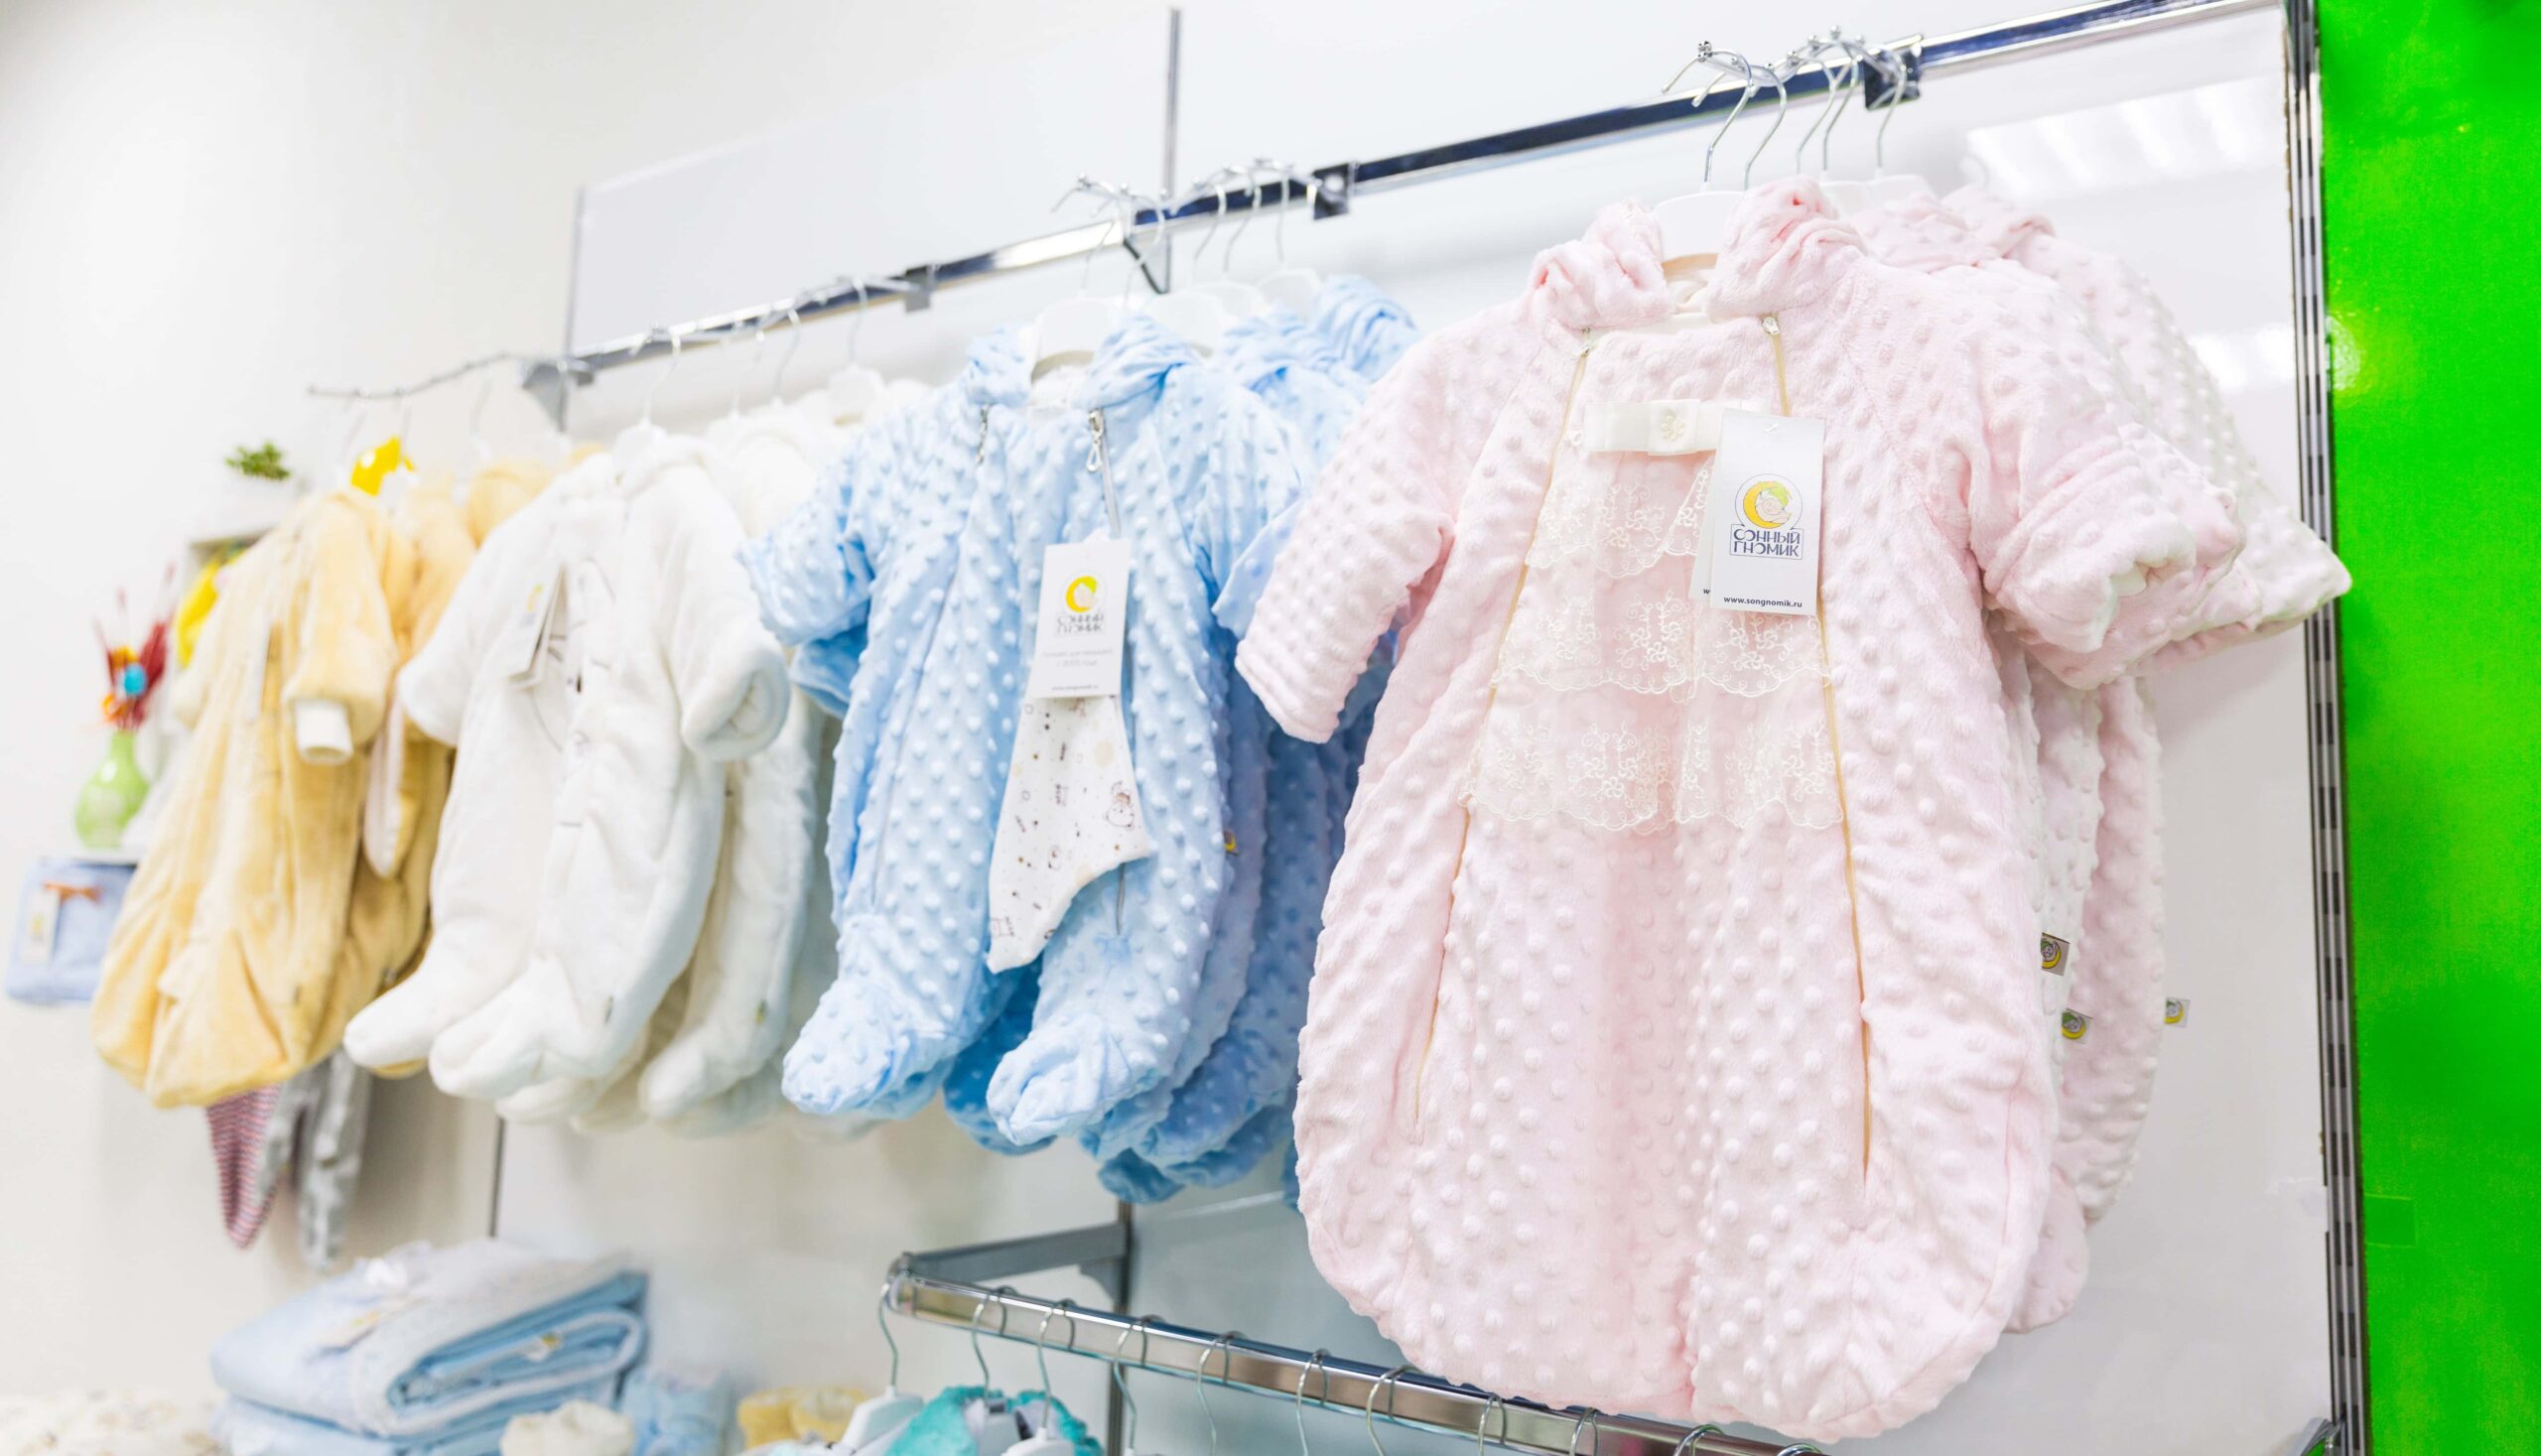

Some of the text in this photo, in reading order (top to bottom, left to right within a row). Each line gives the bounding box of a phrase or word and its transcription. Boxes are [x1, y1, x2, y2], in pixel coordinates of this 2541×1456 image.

[1733, 528, 1801, 545] СОННЫЙ
[1733, 541, 1799, 557] ГНОМИК
[1723, 596, 1803, 607] www.songnomik.ru
